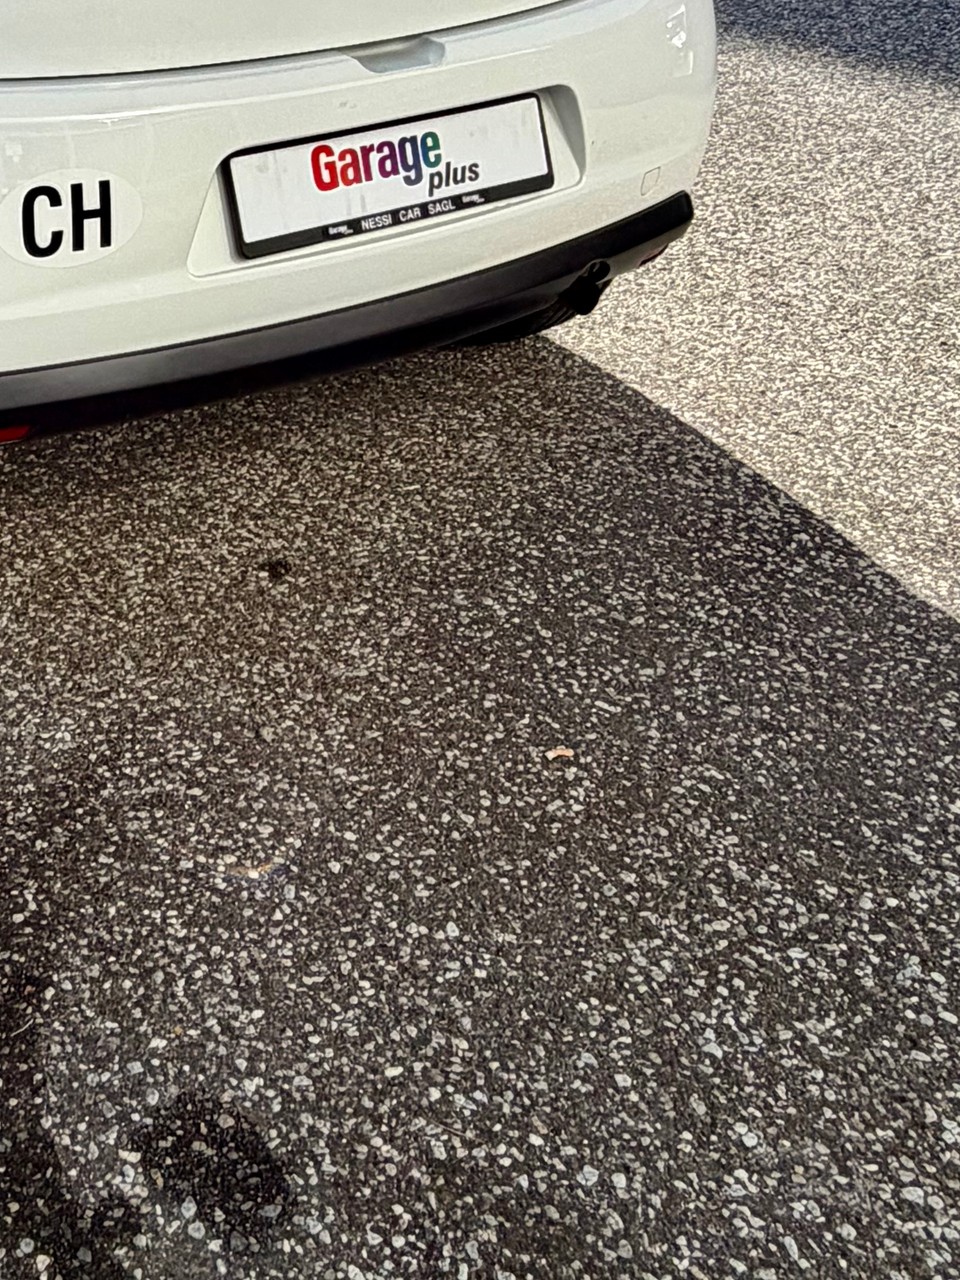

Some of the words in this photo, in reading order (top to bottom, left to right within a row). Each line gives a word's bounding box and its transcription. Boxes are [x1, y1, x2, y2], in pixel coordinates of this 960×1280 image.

[311, 131, 442, 192] Garage
[428, 161, 480, 197] plus
[21, 179, 112, 258] CH
[361, 214, 393, 231] NESSI
[399, 207, 422, 222] CAR
[428, 200, 456, 215] SAGL
